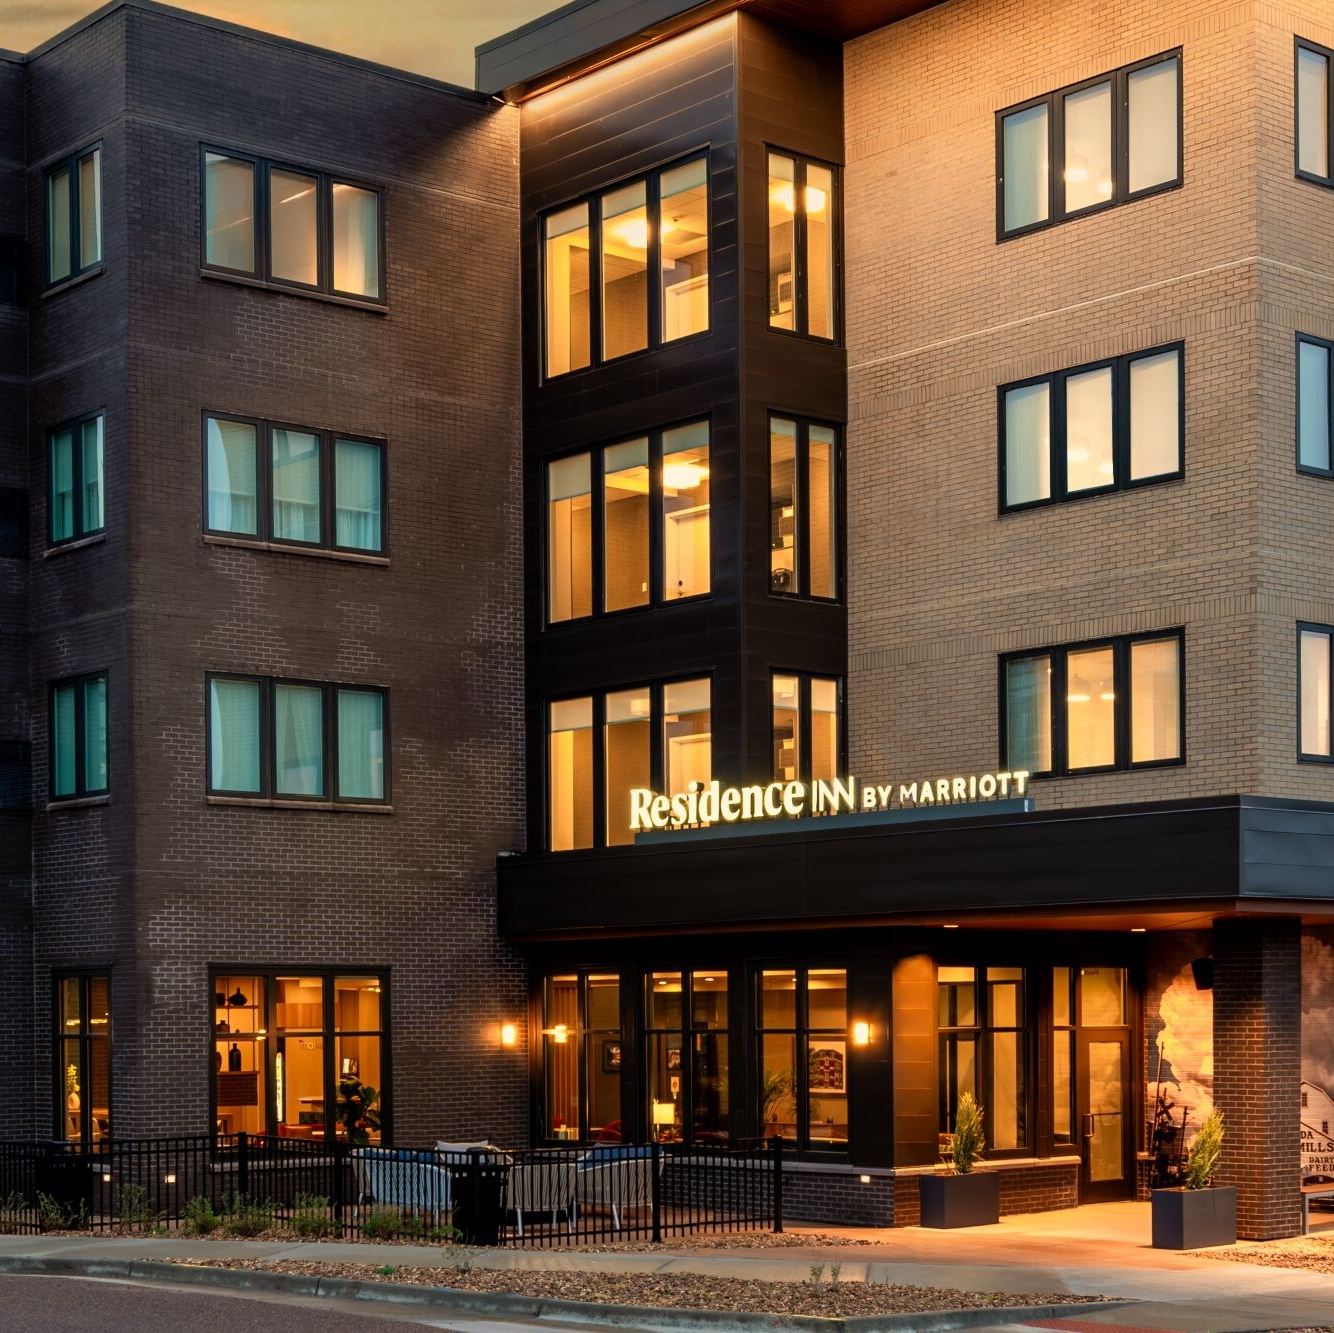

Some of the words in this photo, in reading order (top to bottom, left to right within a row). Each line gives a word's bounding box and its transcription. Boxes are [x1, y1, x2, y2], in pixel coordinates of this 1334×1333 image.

[629, 779, 805, 830] Residence
[812, 775, 855, 813] INN
[863, 785, 892, 808] BY
[899, 770, 1030, 804] MARRIOTT
